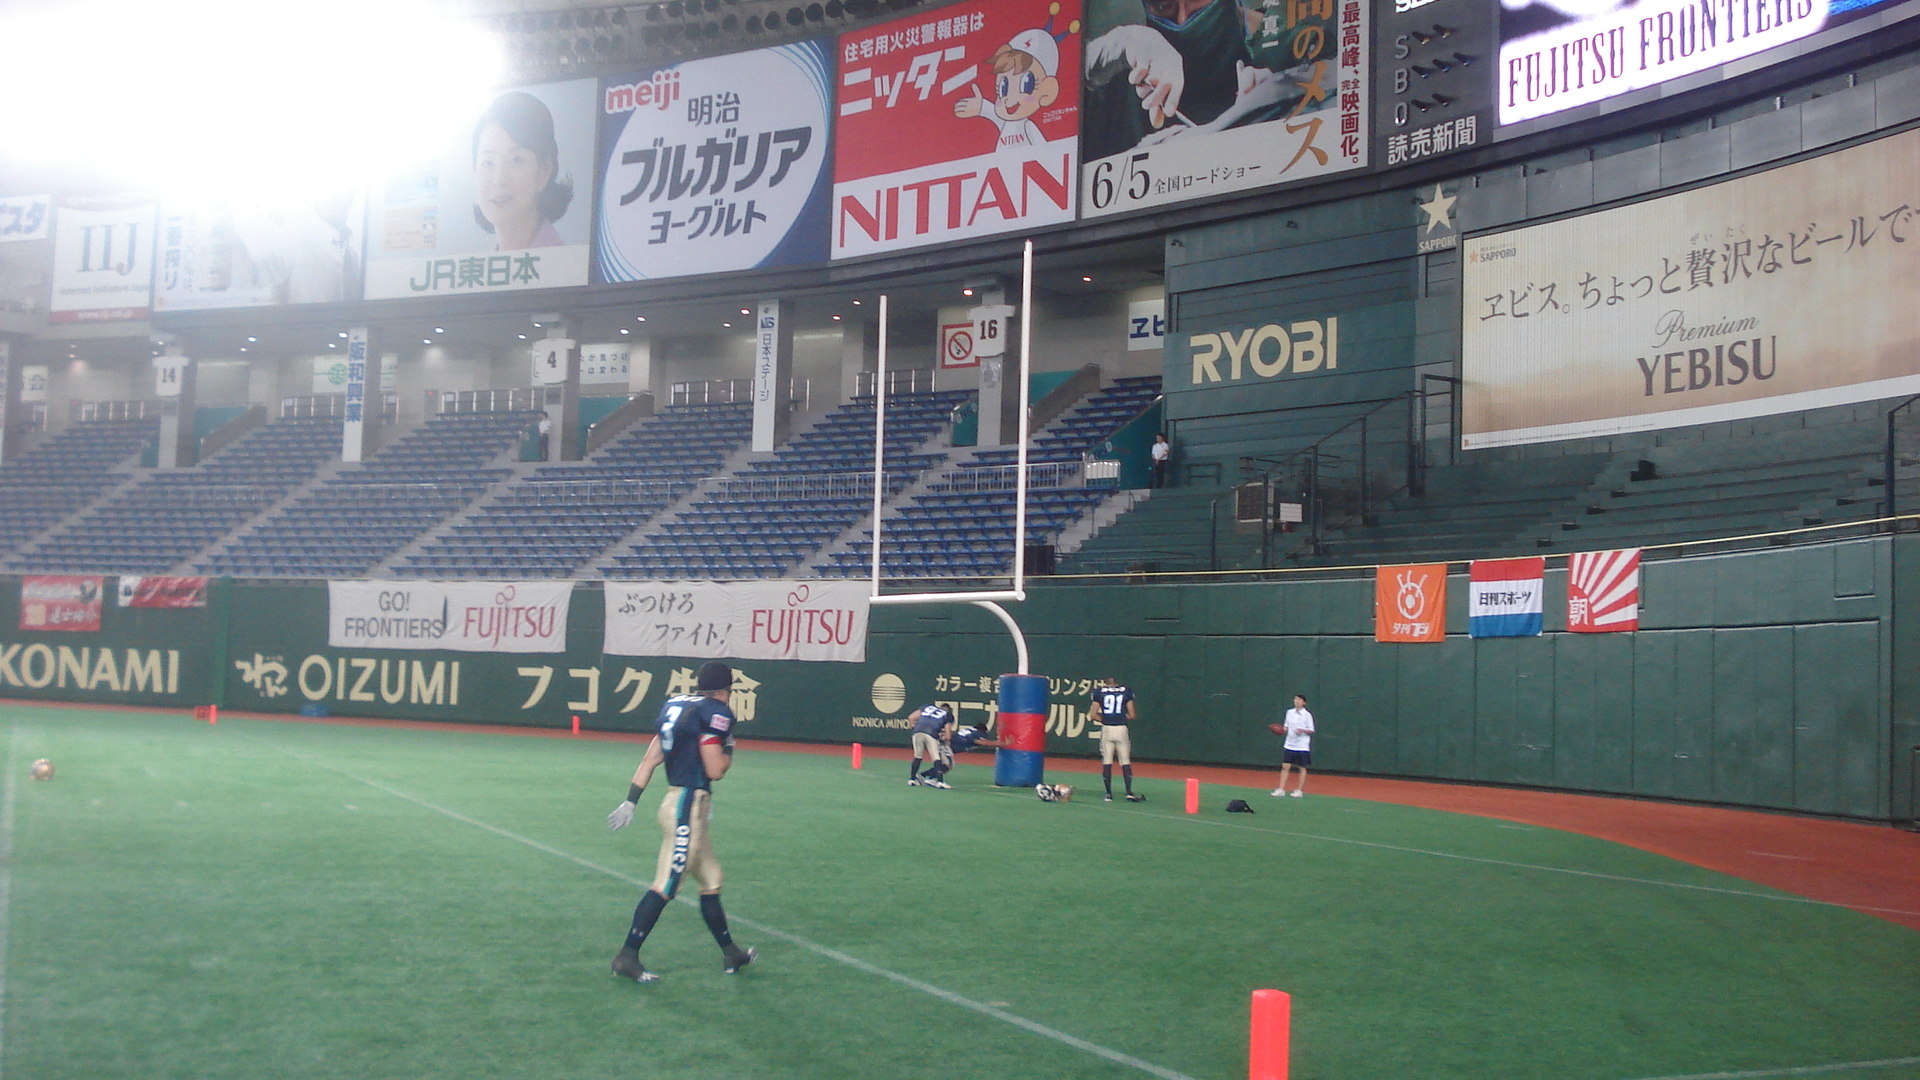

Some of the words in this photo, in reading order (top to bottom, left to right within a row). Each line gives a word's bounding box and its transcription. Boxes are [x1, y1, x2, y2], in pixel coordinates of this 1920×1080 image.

[844, 12, 985, 63] 住宅用火災警報器は
[1394, 34, 1409, 60] S
[840, 45, 978, 117] ニッタン
[1394, 68, 1409, 94] B
[1508, 26, 1625, 108] FUJITSU
[607, 71, 680, 111] meiji
[687, 91, 741, 127] 明治
[1000, 133, 1026, 147] NITTAN
[1388, 115, 1477, 165] 読売新聞
[620, 126, 812, 206] ブルガリア
[1092, 152, 1150, 209] 6/5
[1154, 165, 1262, 195] 全国ロードショー
[839, 153, 1070, 248] NITTAN
[648, 198, 767, 245] ヨーグルト
[78, 222, 142, 276] IIJ
[1480, 247, 1517, 263] SAPPORO
[409, 252, 541, 292] JR東日本
[979, 319, 998, 340] 16
[1652, 309, 1760, 349] Premium
[547, 350, 557, 368] 4
[1190, 317, 1338, 384] RYOBI
[1637, 335, 1776, 397] YEBISU
[162, 367, 176, 383] 14
[379, 591, 411, 612] GO!
[618, 591, 695, 615] ぶつけろ
[1479, 590, 1532, 607] 日刊スポーツ
[1568, 596, 1589, 626] 朝
[344, 617, 444, 640] FRONTIERS
[463, 603, 557, 647] FUJITSU
[750, 608, 856, 655] FUJITSU
[0, 643, 179, 694] KONAMI
[298, 654, 460, 706] OIZUMI
[852, 716, 884, 729] KONICA
[920, 704, 948, 719] 93
[1103, 694, 1124, 714] 91
